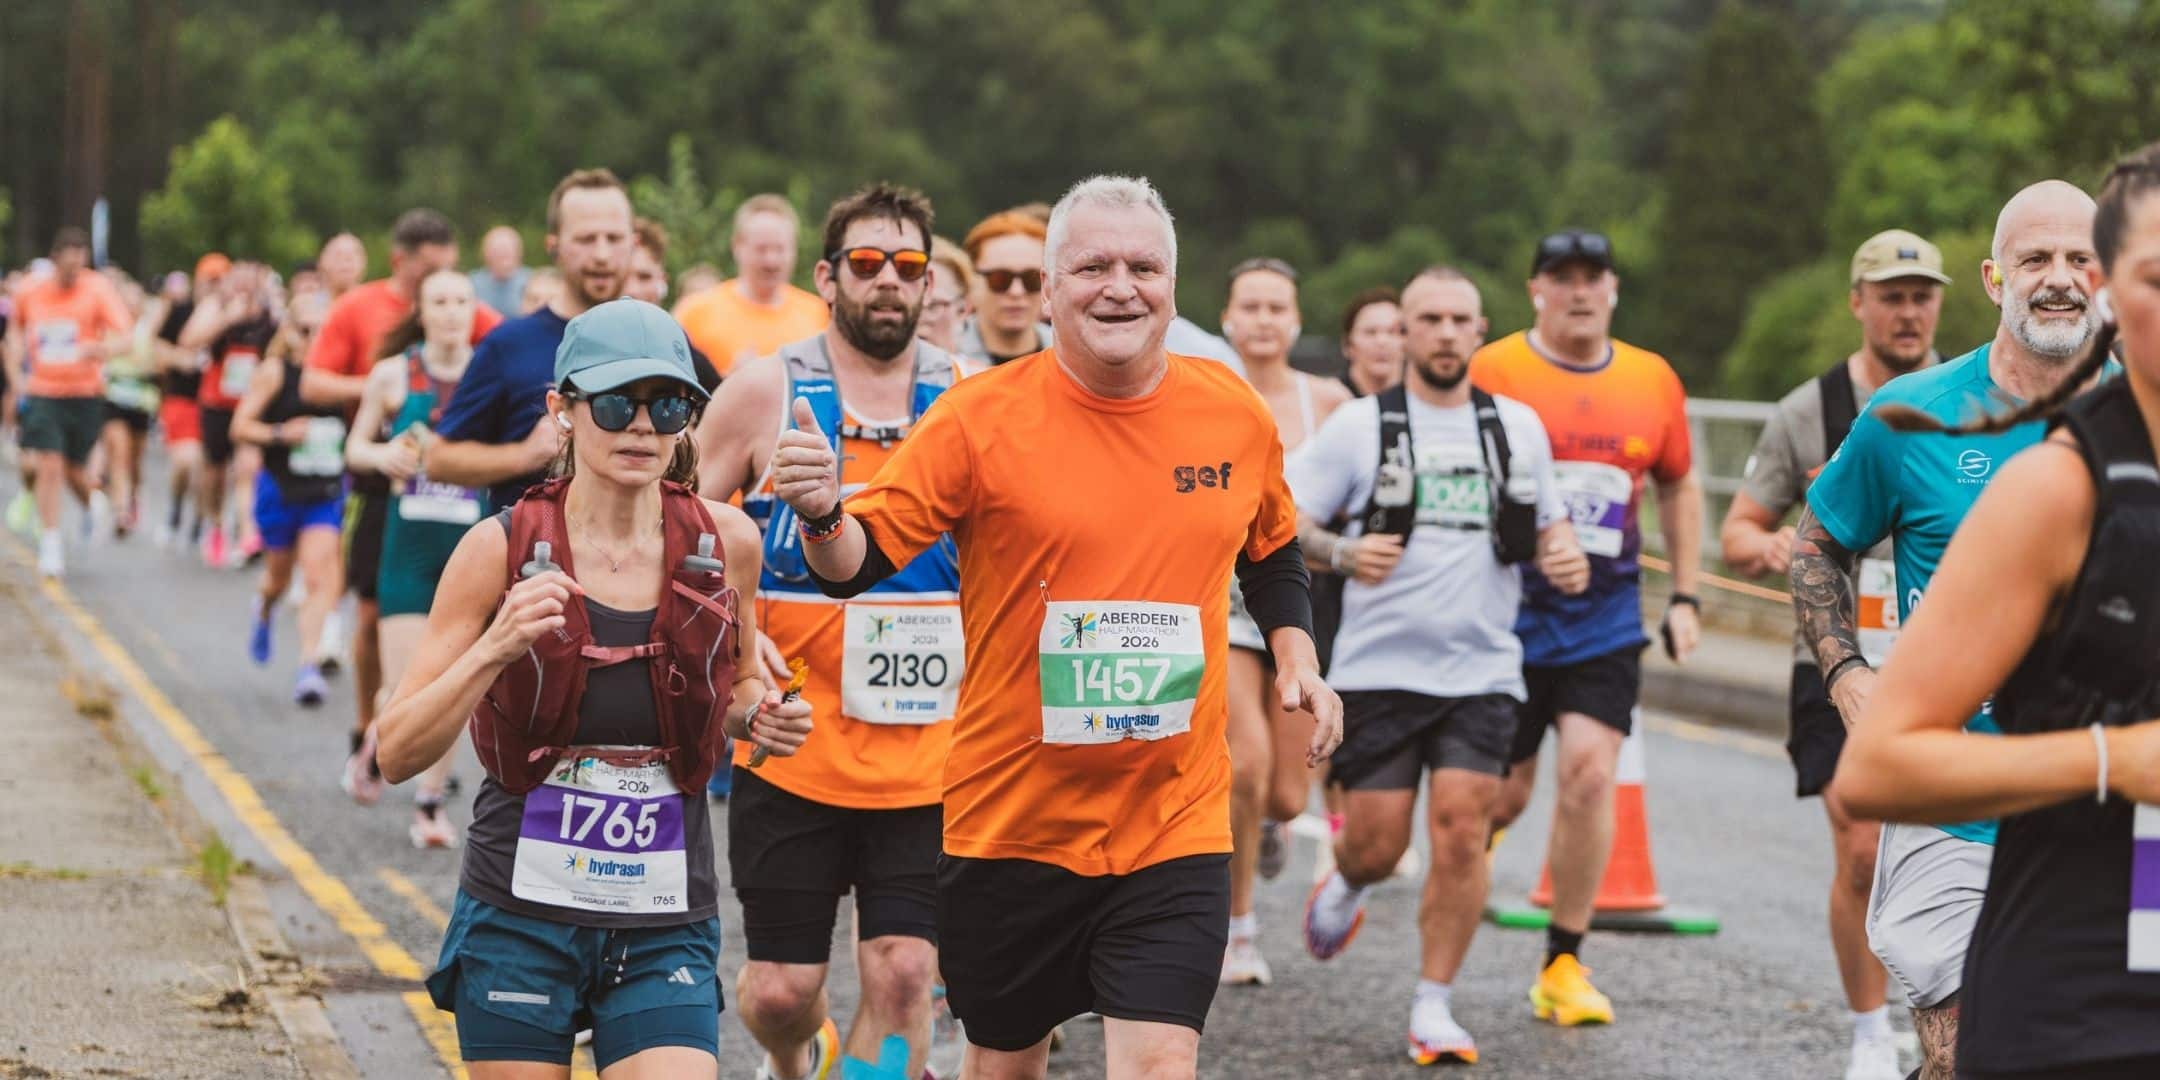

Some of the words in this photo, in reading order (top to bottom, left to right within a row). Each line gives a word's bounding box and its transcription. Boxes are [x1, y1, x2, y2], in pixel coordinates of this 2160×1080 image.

[1173, 461, 1233, 494] gef
[896, 615, 953, 625] ABERDEEN
[1099, 612, 1179, 626] ABERDEEN
[1098, 624, 1123, 636] HALF
[1125, 625, 1180, 636] MARATHON
[1120, 636, 1160, 648] 2026
[867, 652, 948, 688] 2130
[1071, 657, 1172, 703] 1457
[1105, 713, 1160, 730] hydrasun
[559, 793, 661, 849] 1765
[652, 896, 677, 905] 1765
